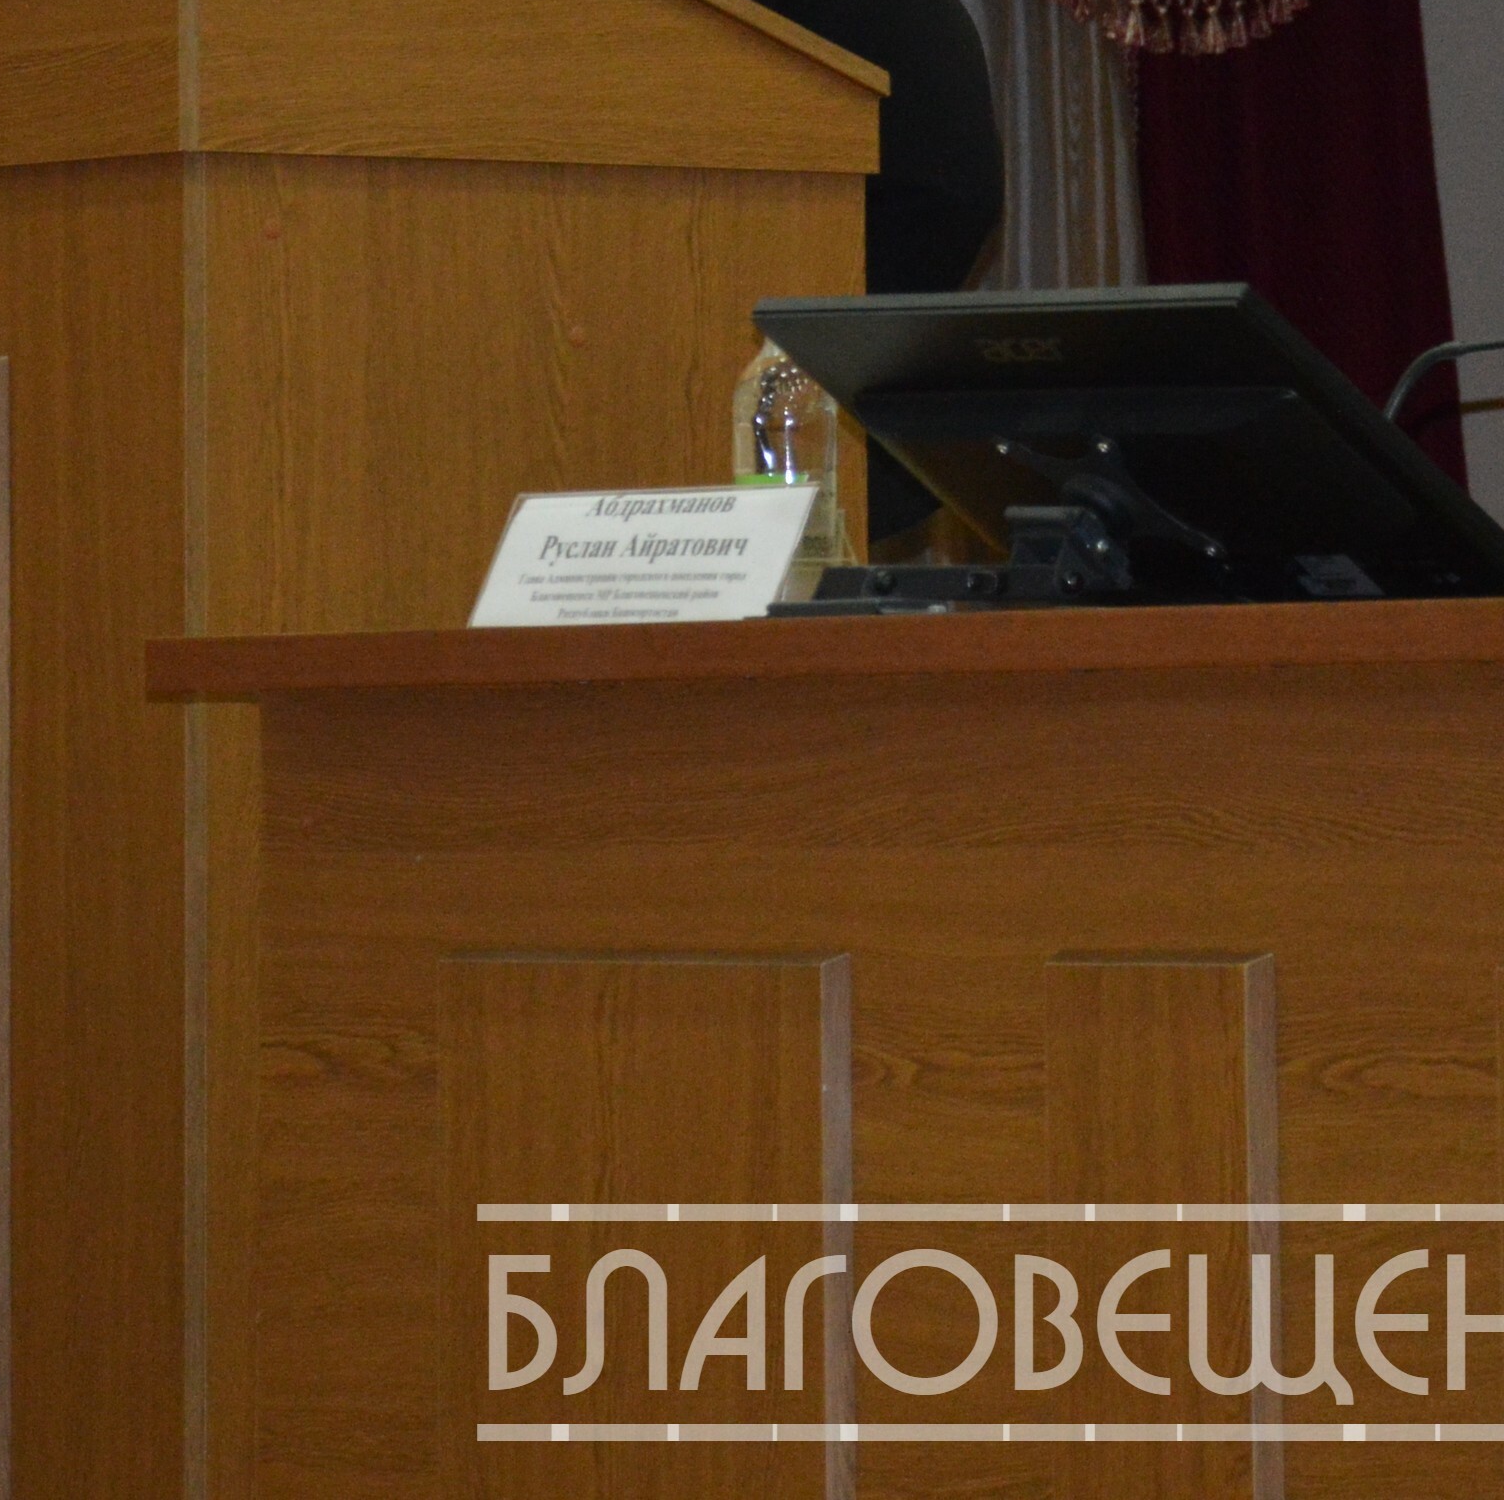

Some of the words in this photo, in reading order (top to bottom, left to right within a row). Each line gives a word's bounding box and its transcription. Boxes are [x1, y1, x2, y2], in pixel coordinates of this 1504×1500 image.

[585, 494, 737, 523] Абдрахманов
[538, 534, 617, 567] Руслан
[620, 533, 749, 565] Айратович
